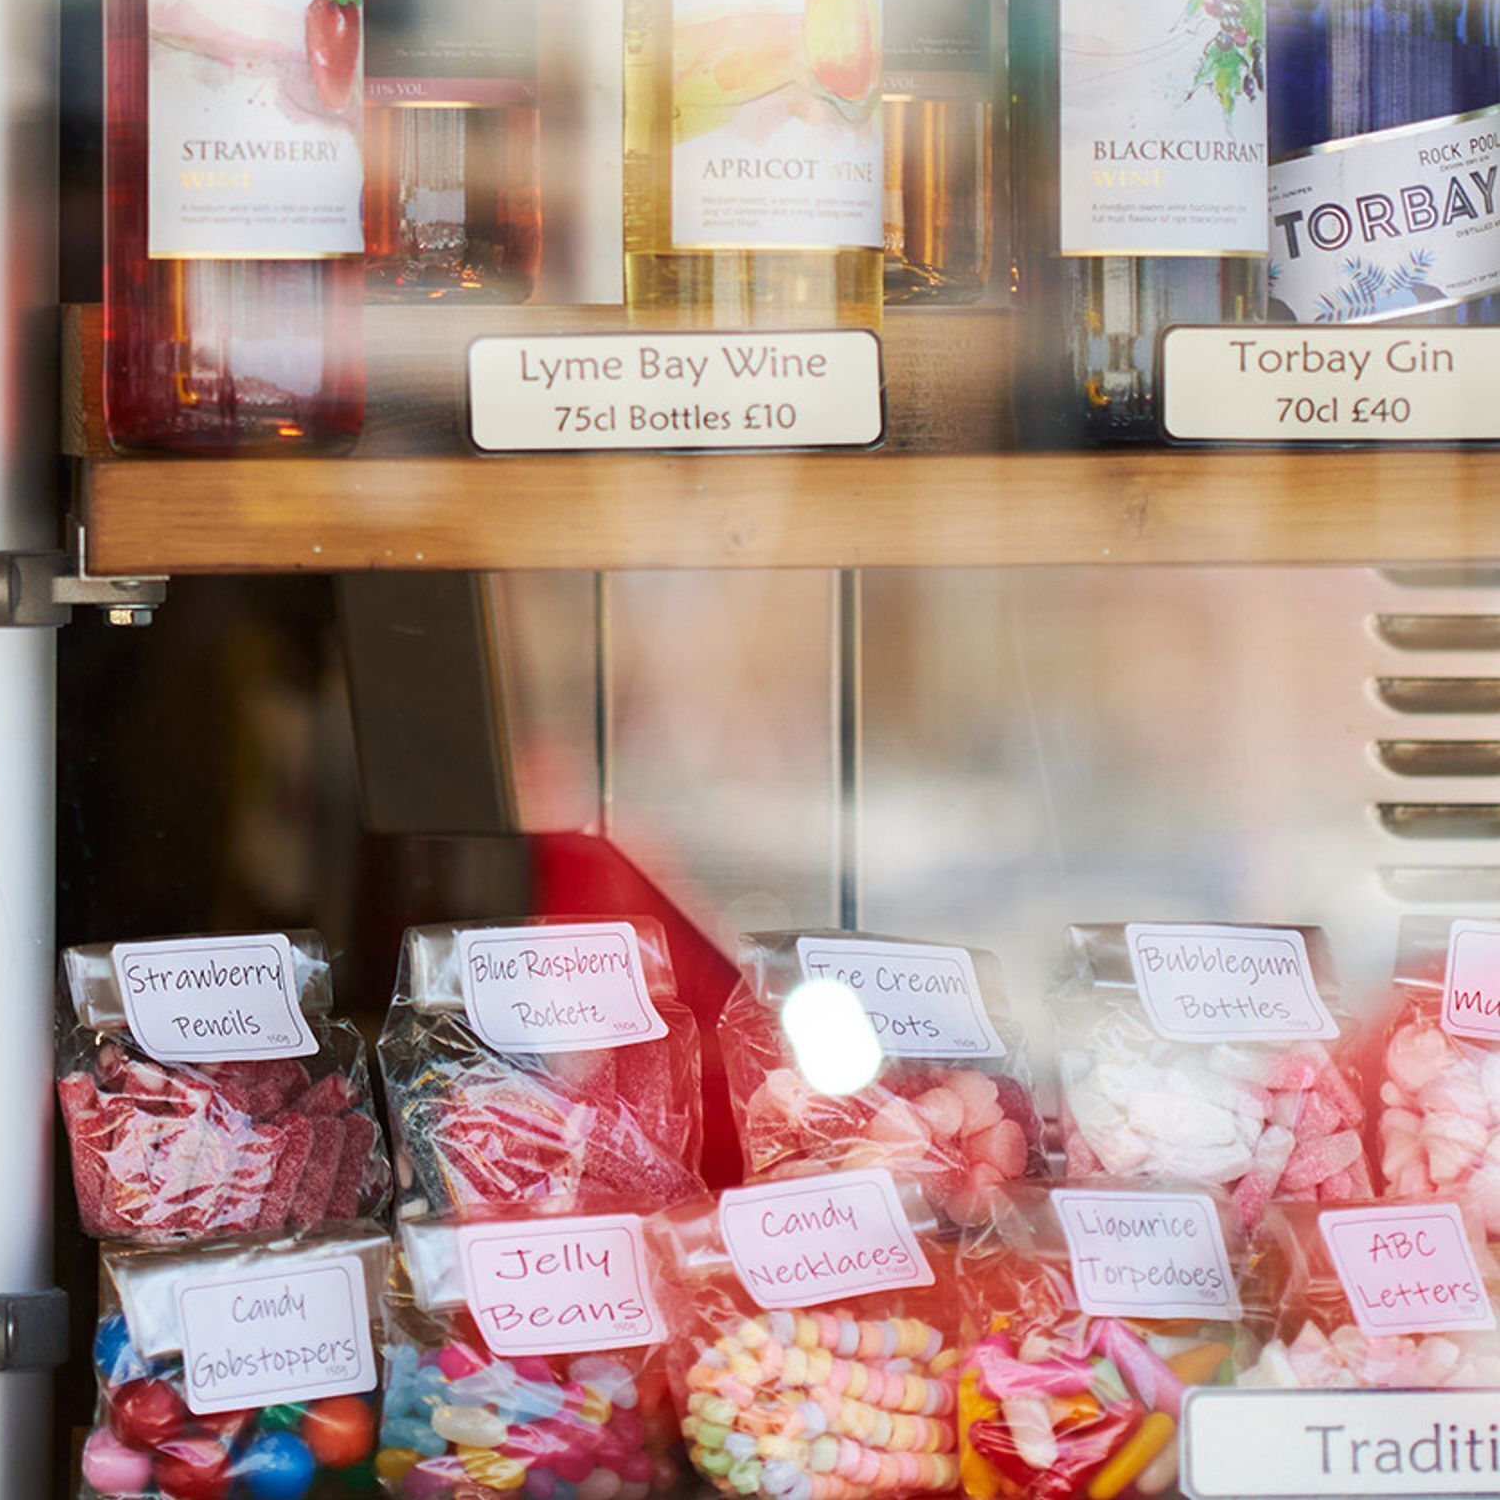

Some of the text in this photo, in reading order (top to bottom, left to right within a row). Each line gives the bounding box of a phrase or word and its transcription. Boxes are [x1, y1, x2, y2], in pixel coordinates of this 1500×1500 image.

[182, 139, 341, 162] STRAWBERRY
[1418, 142, 1462, 166] ROCK
[1469, 133, 1500, 155] POOL
[702, 158, 873, 182] APRICOT WINE
[1274, 165, 1498, 260] TORBAY
[521, 347, 827, 389] Lyme Bay Wine
[1230, 341, 1454, 381] Torbay Gin
[555, 403, 796, 432] 75cl Bottles £10
[1277, 397, 1411, 423] 70cl £40
[127, 960, 283, 994] Strawberry
[470, 947, 632, 983] Blue Raspberry
[876, 967, 968, 996] Cream
[1139, 945, 1300, 985] Bubblegum
[172, 1009, 261, 1040] Pencils
[1174, 995, 1292, 1020] Bottles
[761, 1198, 859, 1238] Candy
[496, 1242, 611, 1280] Jelly
[1368, 1231, 1436, 1264] ABC
[748, 1245, 909, 1288] Necklaces
[1079, 1256, 1223, 1292] Torpedoes
[232, 1286, 307, 1323] Candy
[1357, 1282, 1480, 1309] Letters
[480, 1299, 644, 1331] Beans
[192, 1337, 356, 1389] Gobstoppers
[1304, 1422, 1500, 1474] Traditi
